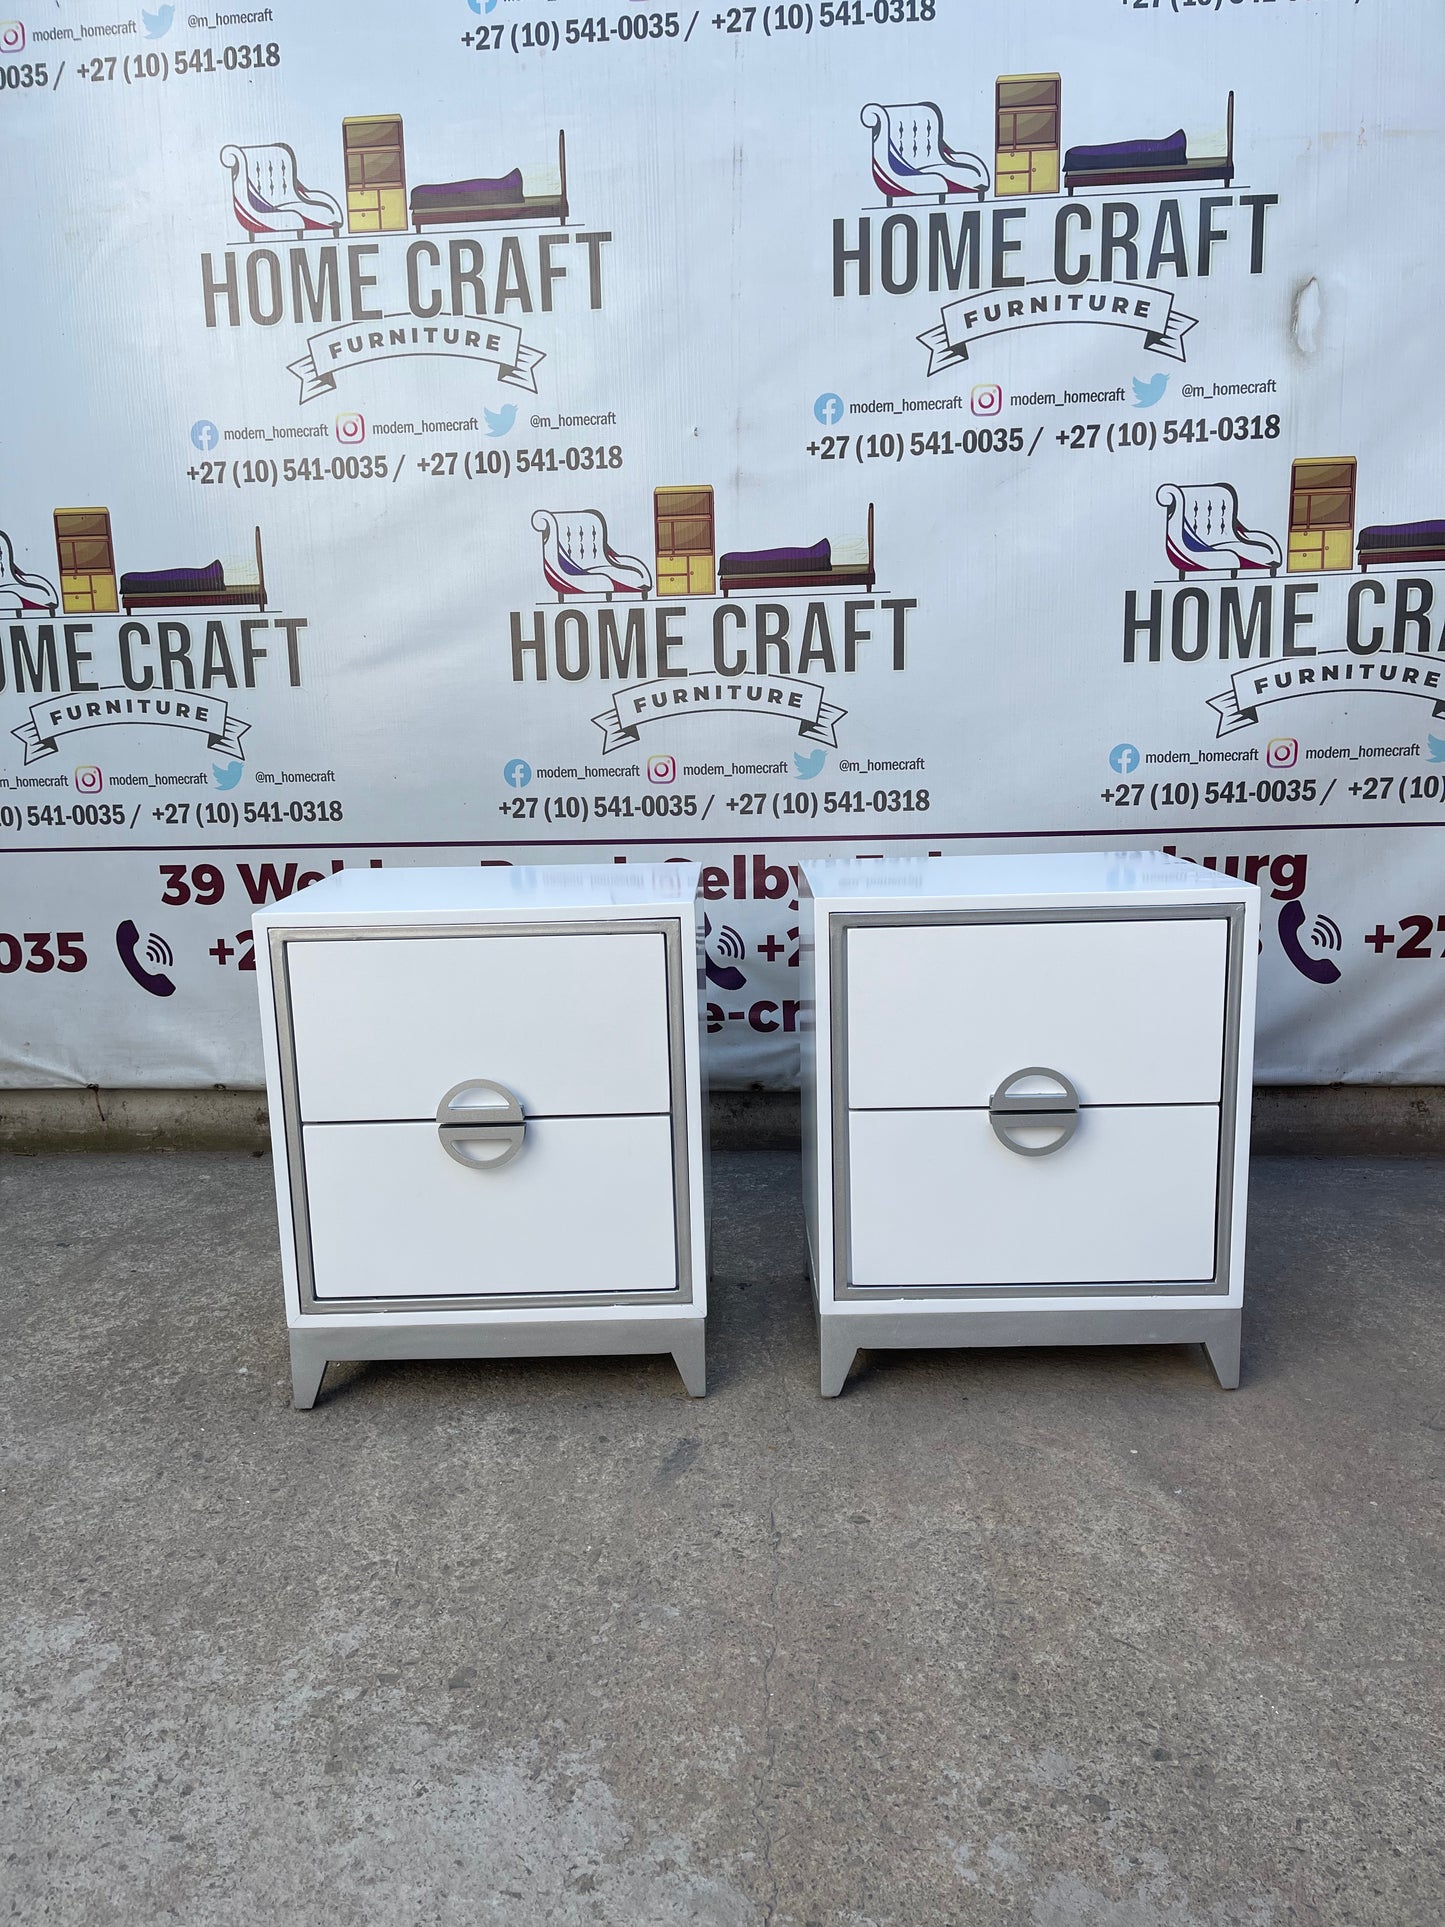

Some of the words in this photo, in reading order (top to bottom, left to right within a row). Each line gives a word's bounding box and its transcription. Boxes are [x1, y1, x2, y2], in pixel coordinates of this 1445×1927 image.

[187, 7, 274, 30] @m_homecraft
[460, 24, 505, 51] +27
[510, 20, 560, 54] (10)
[565, 11, 680, 45] 541-0035
[683, 10, 700, 43] /
[711, 6, 757, 34] +27
[763, 3, 814, 37] (10)
[819, 0, 936, 28] 541-0318
[52, 60, 66, 92] /
[76, 56, 117, 82] +27
[123, 52, 169, 85] (10)
[174, 42, 281, 75] 541-0318
[832, 207, 1027, 297] HOME
[1053, 193, 1278, 286] CRAFT
[201, 243, 383, 328] HOME
[406, 231, 612, 318] CRAFT
[963, 293, 1152, 329] FURNITURE
[327, 325, 503, 361] FURNITURE
[1181, 378, 1277, 400] @m_homecraft
[529, 411, 617, 430] @m_homecraft
[806, 435, 850, 460] +27
[855, 433, 904, 464] (10)
[909, 427, 1024, 456] 541-0035
[1027, 426, 1045, 457] /
[1055, 424, 1101, 450] +27
[1106, 421, 1157, 453] (10)
[1162, 413, 1281, 445] 541-0318
[186, 461, 227, 485] +27
[232, 459, 278, 489] (10)
[283, 454, 389, 482] 541-0035
[391, 454, 406, 483] /
[416, 451, 458, 476] +27
[464, 449, 511, 480] (10)
[516, 445, 623, 473] 541-0318
[1123, 582, 1319, 663] HOME
[1346, 577, 1445, 656] CR
[0, 624, 99, 693] ME
[118, 618, 308, 692] CRAFT
[510, 607, 687, 681] HOME
[712, 598, 917, 678] CRAFT
[1252, 662, 1443, 696] FURNITURE
[48, 697, 211, 727] FURNITURE
[631, 683, 805, 715] FURNITURE
[255, 769, 336, 786] @m_homecraft
[839, 757, 926, 774] @m_homecraft
[498, 797, 539, 819] +27
[544, 796, 589, 824] (10)
[593, 794, 698, 818] 541-0035
[700, 794, 716, 821] /
[725, 793, 767, 815] +27
[772, 791, 818, 820] (10)
[823, 789, 930, 814] 541-0318
[1100, 783, 1145, 807] +27
[1150, 782, 1199, 811] (10)
[1204, 778, 1317, 805] 541-0035
[1319, 778, 1338, 806] /
[1348, 776, 1394, 800] +27
[0, 805, 23, 832] 0)
[26, 804, 126, 827] 541-0035
[129, 803, 142, 830] /
[152, 803, 190, 825] +27
[195, 802, 239, 829] (10)
[243, 800, 344, 824] 541-0318
[159, 863, 226, 906] 39
